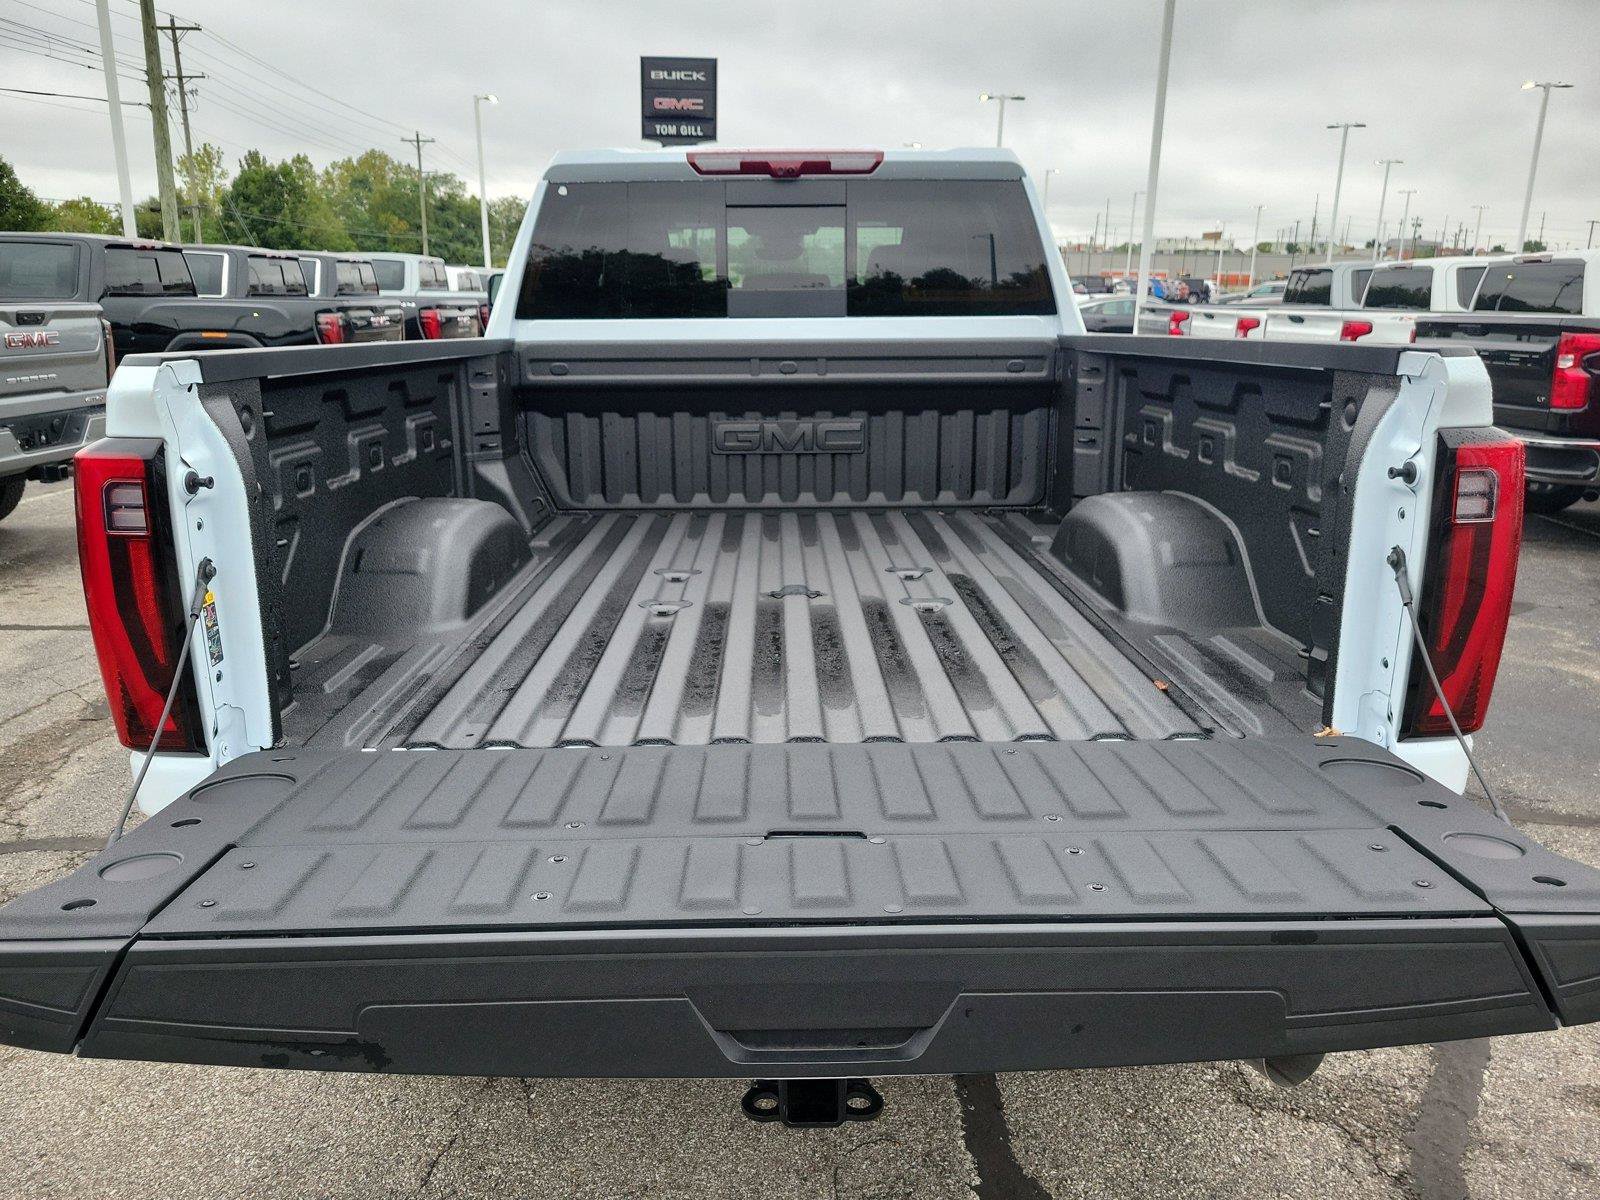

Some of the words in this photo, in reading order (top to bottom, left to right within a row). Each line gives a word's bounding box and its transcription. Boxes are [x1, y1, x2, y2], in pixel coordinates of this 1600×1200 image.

[650, 70, 706, 81] BUICK
[653, 97, 704, 110] GMC
[655, 124, 677, 136] TOM
[680, 124, 704, 136] GILL
[4, 331, 60, 349] GMC
[714, 422, 863, 451] GMC
